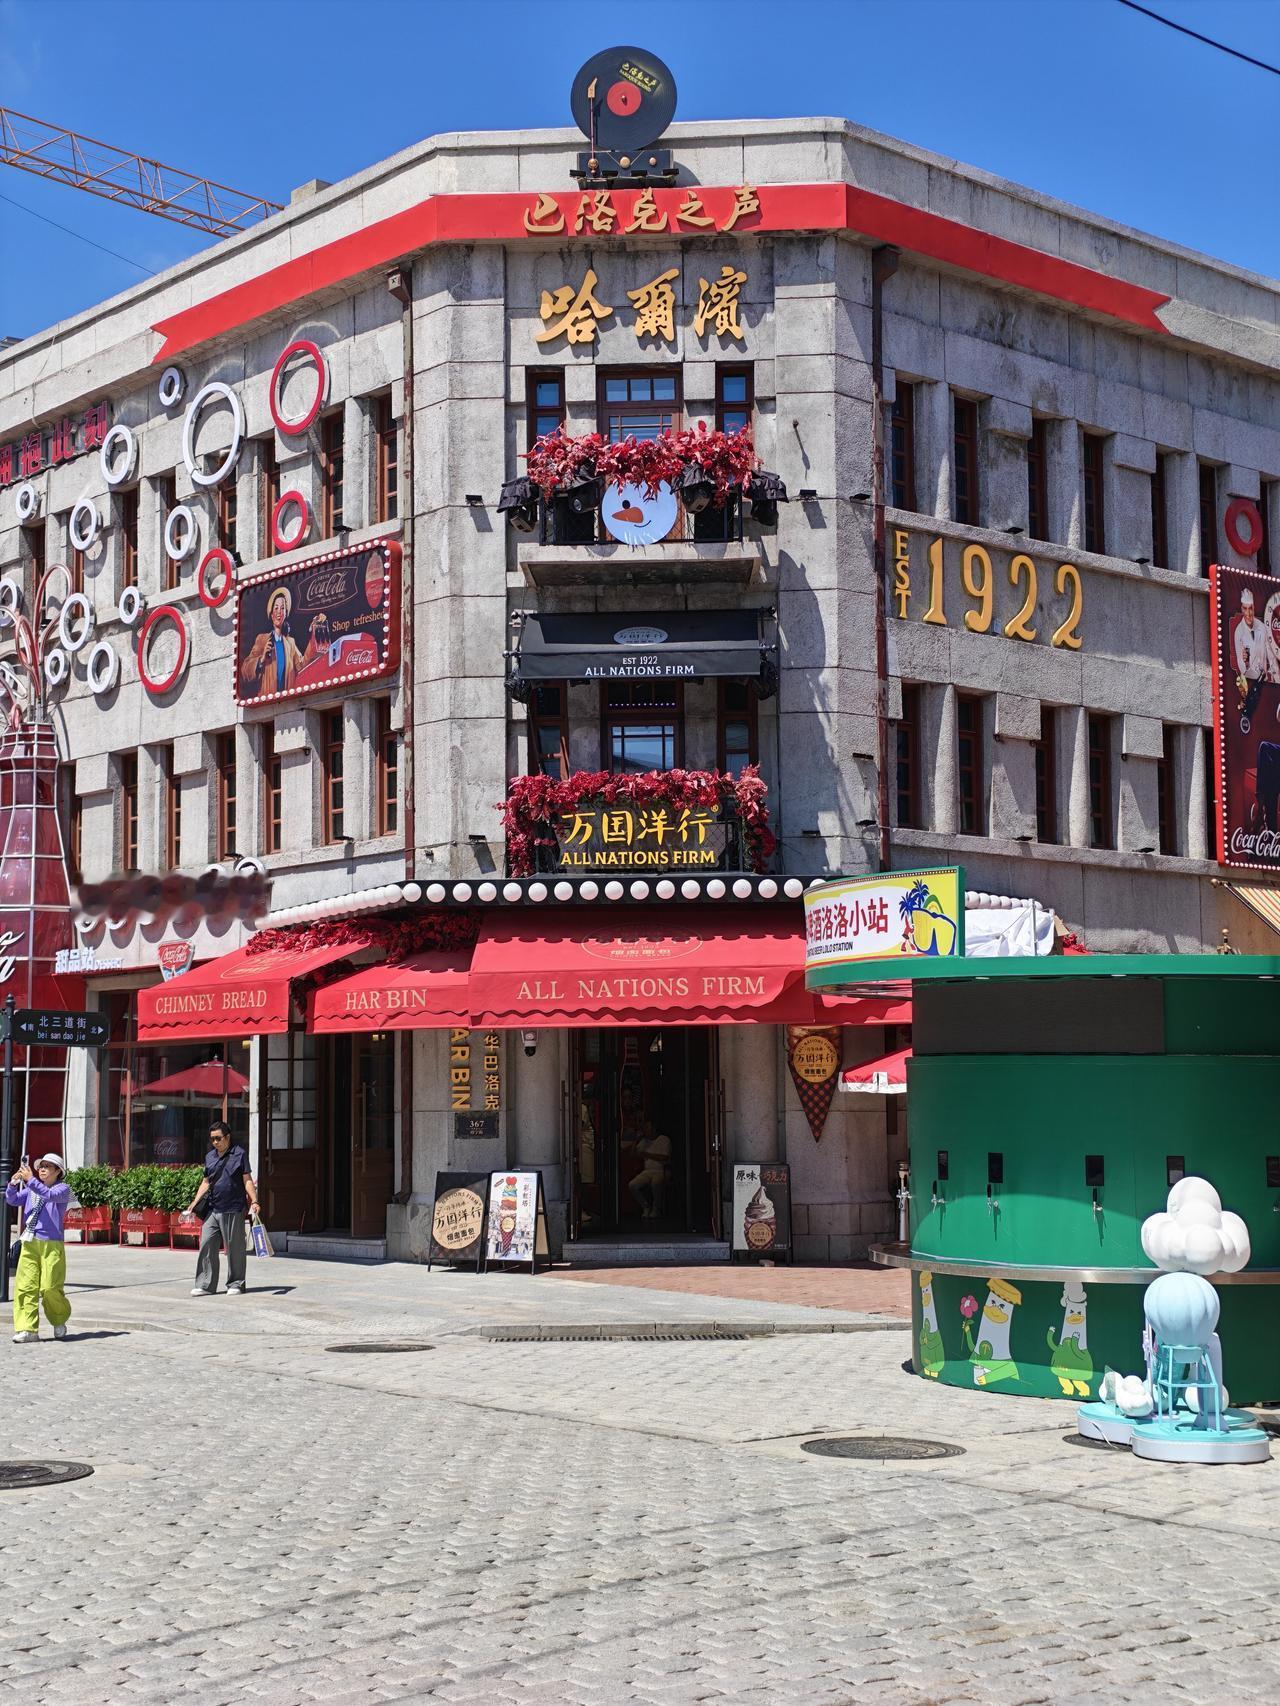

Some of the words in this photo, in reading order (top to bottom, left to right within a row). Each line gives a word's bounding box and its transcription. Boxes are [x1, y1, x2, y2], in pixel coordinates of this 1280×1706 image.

[523, 183, 760, 233] 巴洛克之声
[895, 530, 912, 619] EST
[922, 537, 1083, 649] 1922
[331, 620, 350, 632] Shop
[639, 655, 658, 666] 1922
[585, 666, 606, 676] ALL
[609, 665, 662, 676] NATIONS
[665, 665, 695, 675] FIRM
[561, 808, 713, 846] 万国洋行
[560, 852, 590, 865] ALL
[595, 851, 669, 865] NATIONS
[673, 850, 715, 864] FIRM
[832, 941, 854, 953] STATION
[516, 981, 565, 1000] ALL
[578, 977, 690, 999] NATIONS
[702, 975, 766, 996] FIRM
[155, 993, 215, 1015] CHIMNEY
[222, 990, 267, 1010] BREAD
[39, 1016, 87, 1029] 北三道街
[90, 1026, 97, 1034] 北
[37, 1030, 48, 1039] bei
[63, 1031, 74, 1040] dao
[76, 1032, 86, 1042] jie
[484, 1030, 500, 1111] 华巴洛克
[469, 1120, 485, 1128] 367
